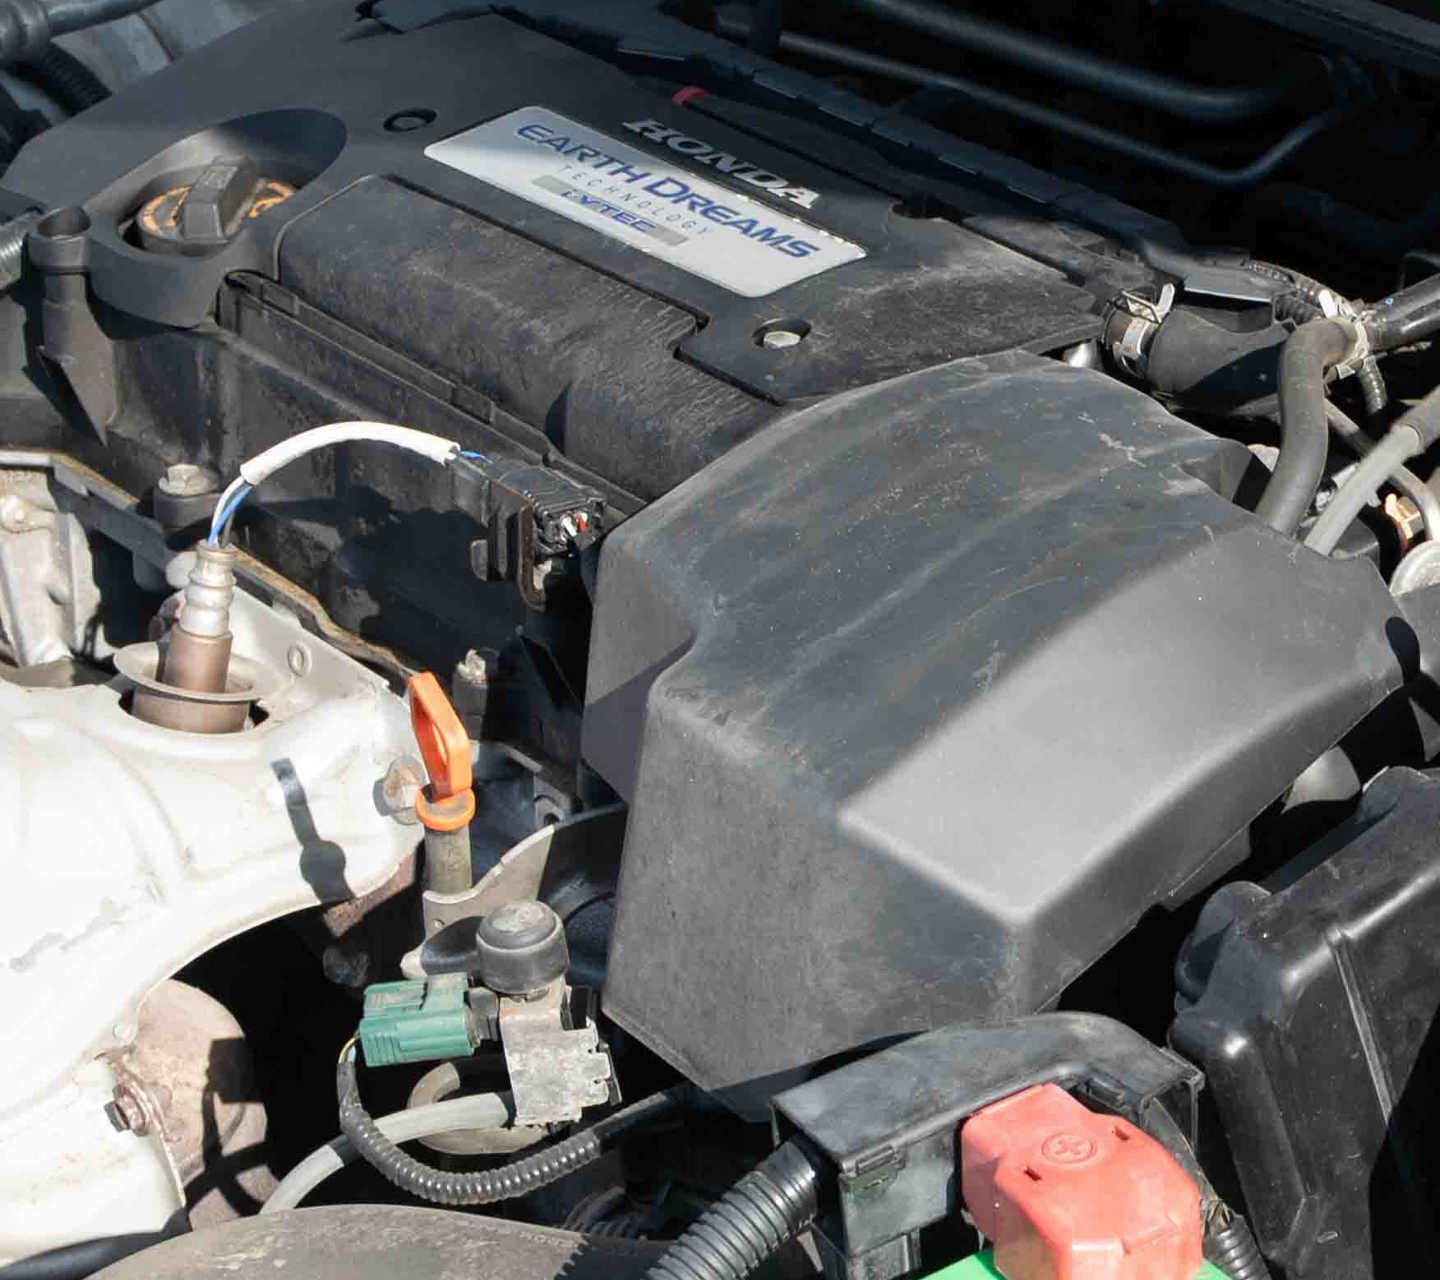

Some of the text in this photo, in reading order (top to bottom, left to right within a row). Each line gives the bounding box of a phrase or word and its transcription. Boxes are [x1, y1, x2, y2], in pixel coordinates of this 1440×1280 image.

[516, 123, 820, 259] EARTH DREAMS
[561, 164, 712, 236] TECHNOLOGY
[623, 119, 821, 209] HONDA
